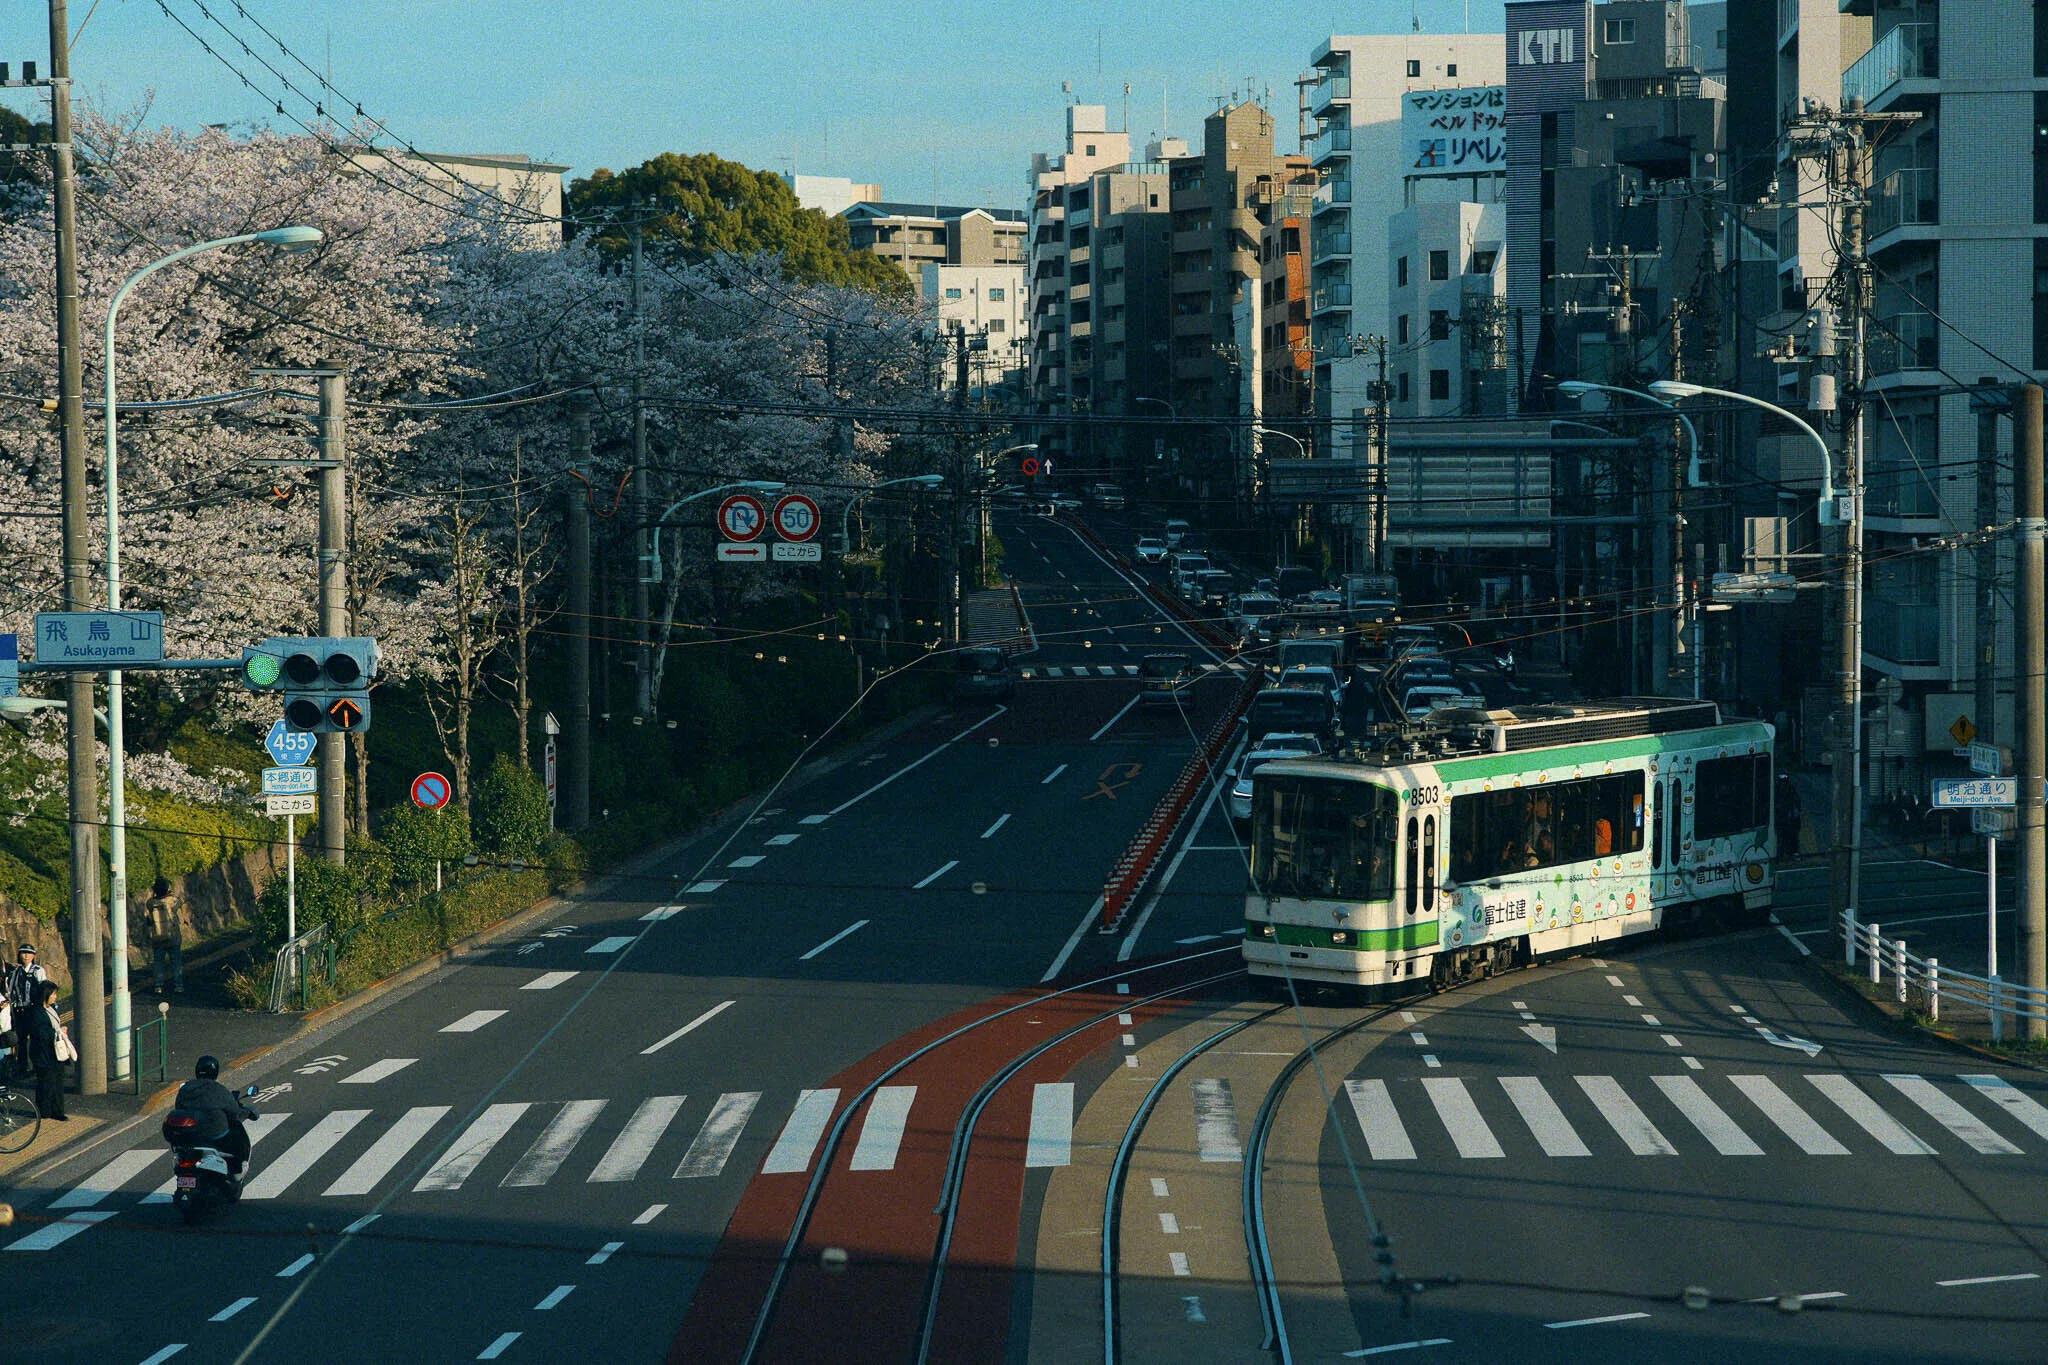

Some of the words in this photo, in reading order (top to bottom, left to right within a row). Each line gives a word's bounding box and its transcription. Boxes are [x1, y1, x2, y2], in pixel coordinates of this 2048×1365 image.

[1411, 91, 1505, 110] マンションは
[1452, 137, 1507, 165] リベレ
[784, 508, 809, 528] 50
[778, 546, 817, 557] ここから
[45, 619, 151, 641] 飛鳥山
[63, 644, 136, 658] Asukayama
[273, 732, 309, 751] 455
[280, 753, 302, 761] 東京
[265, 771, 312, 783] 本郷通り
[1411, 786, 1439, 806] 8503
[1947, 782, 2007, 795] 明治通り
[270, 799, 312, 811] ここから
[1484, 898, 1526, 926] 富士住建
